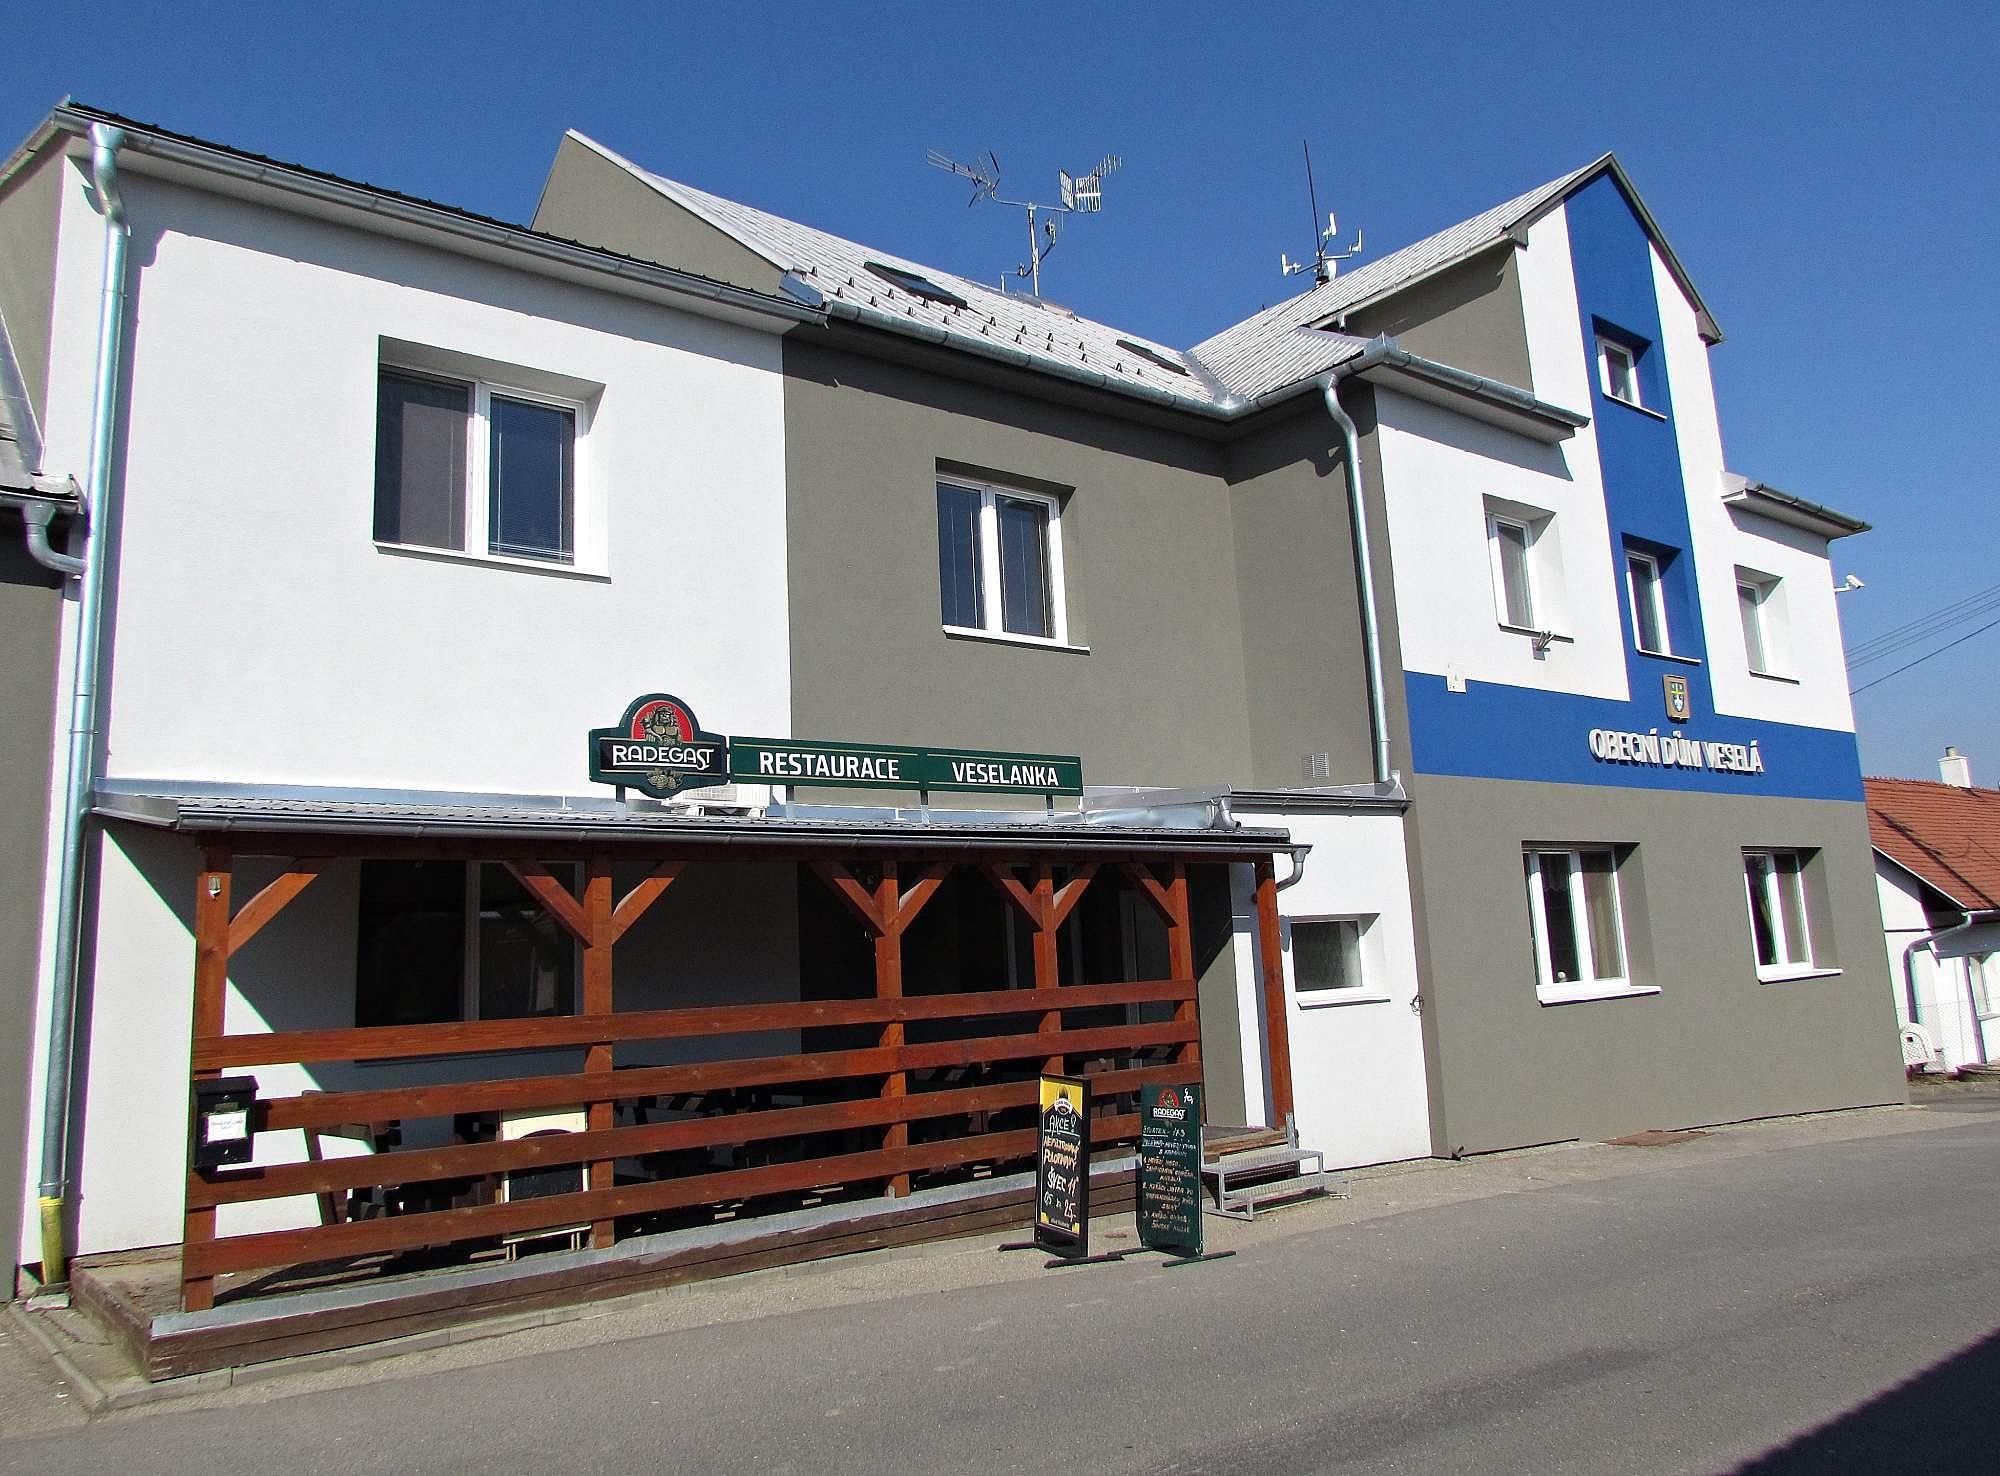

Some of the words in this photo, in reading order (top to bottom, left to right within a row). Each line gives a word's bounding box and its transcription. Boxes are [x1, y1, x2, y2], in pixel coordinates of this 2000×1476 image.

[612, 744, 715, 771] RADEGAST
[1589, 728, 1660, 764] OBECNÍ
[1660, 731, 1702, 768] DŮM
[1702, 739, 1764, 773] VESELÁ
[758, 752, 900, 781] RESTAURACE
[951, 760, 1060, 788] VESELANKA
[1153, 1107, 1185, 1120] RADEGAST
[1047, 1165, 1066, 1192] ŠVEC
